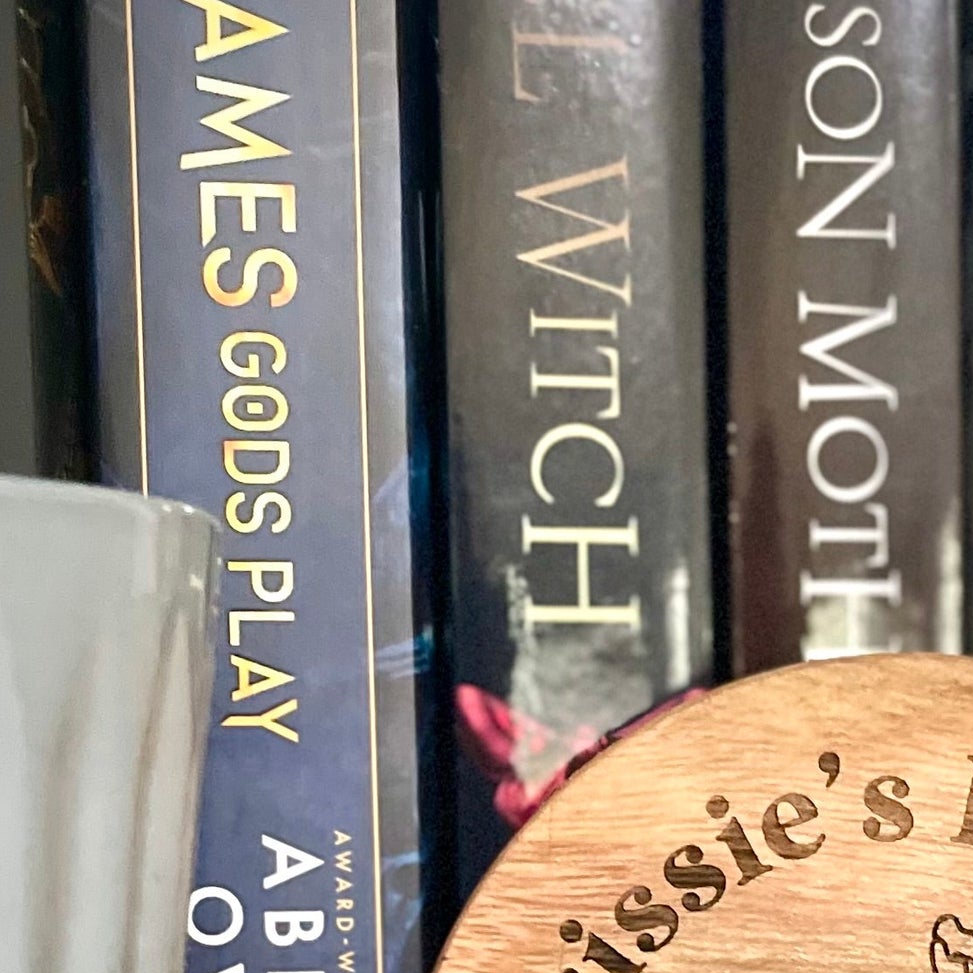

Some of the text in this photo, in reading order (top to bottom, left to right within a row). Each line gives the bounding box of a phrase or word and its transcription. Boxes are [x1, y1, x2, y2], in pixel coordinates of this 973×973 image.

[220, 331, 292, 534] GODS
[514, 156, 641, 633] WITCH
[796, 3, 901, 662] SON MOTH
[221, 561, 299, 743] PLAY
